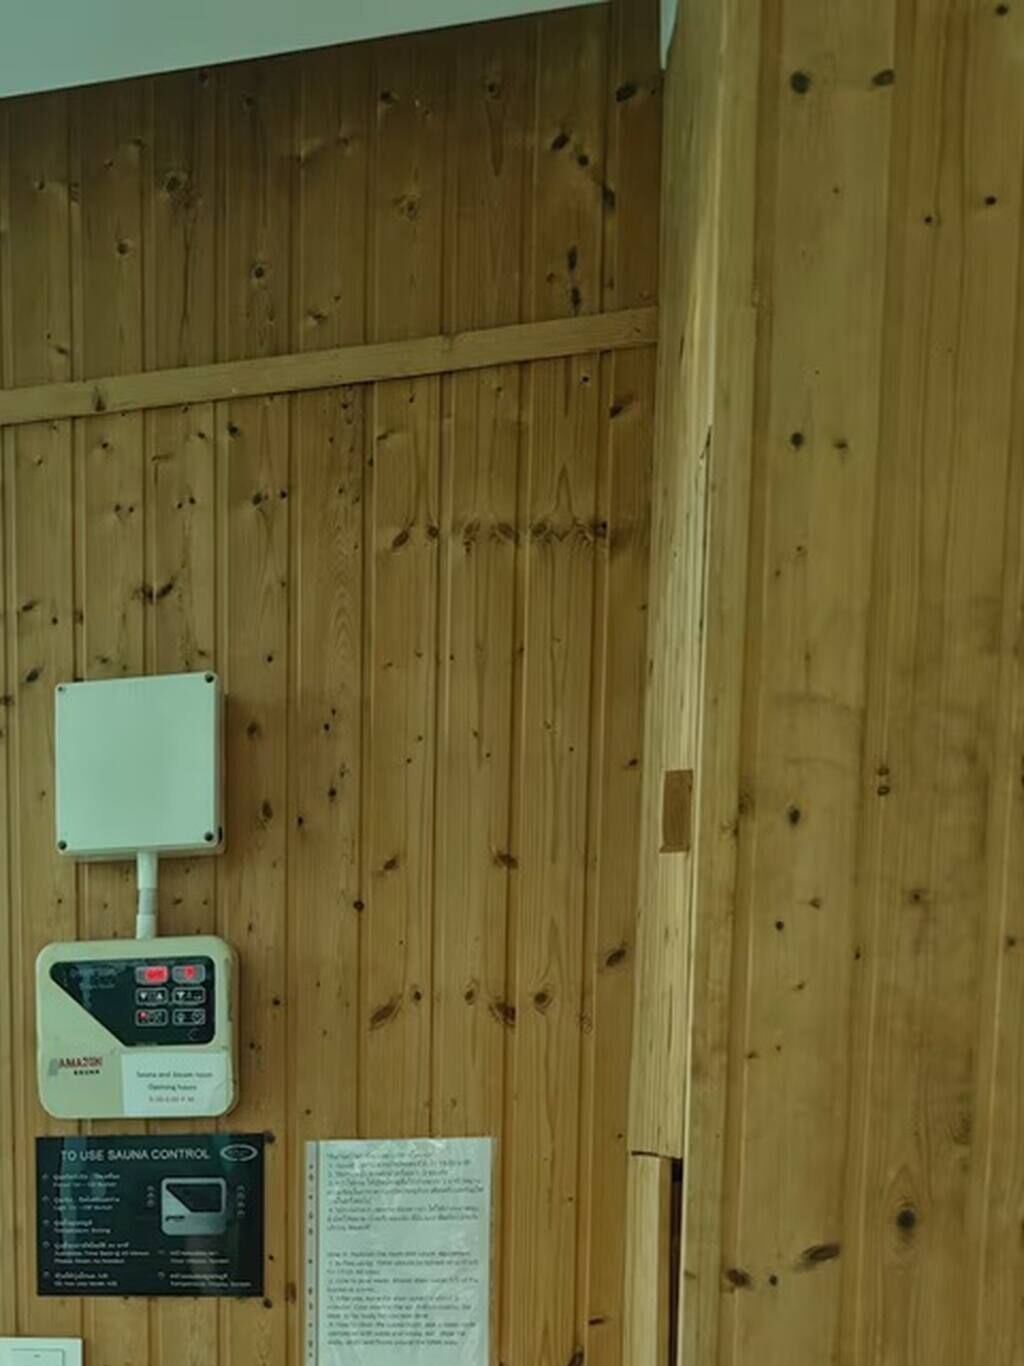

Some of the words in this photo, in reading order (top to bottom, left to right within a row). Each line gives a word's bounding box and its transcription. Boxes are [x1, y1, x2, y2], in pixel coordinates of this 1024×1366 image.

[61, 1149, 77, 1161] TO
[80, 1149, 104, 1161] USE
[108, 1149, 150, 1161] SAUNA
[151, 1147, 211, 1160] CONTROL
